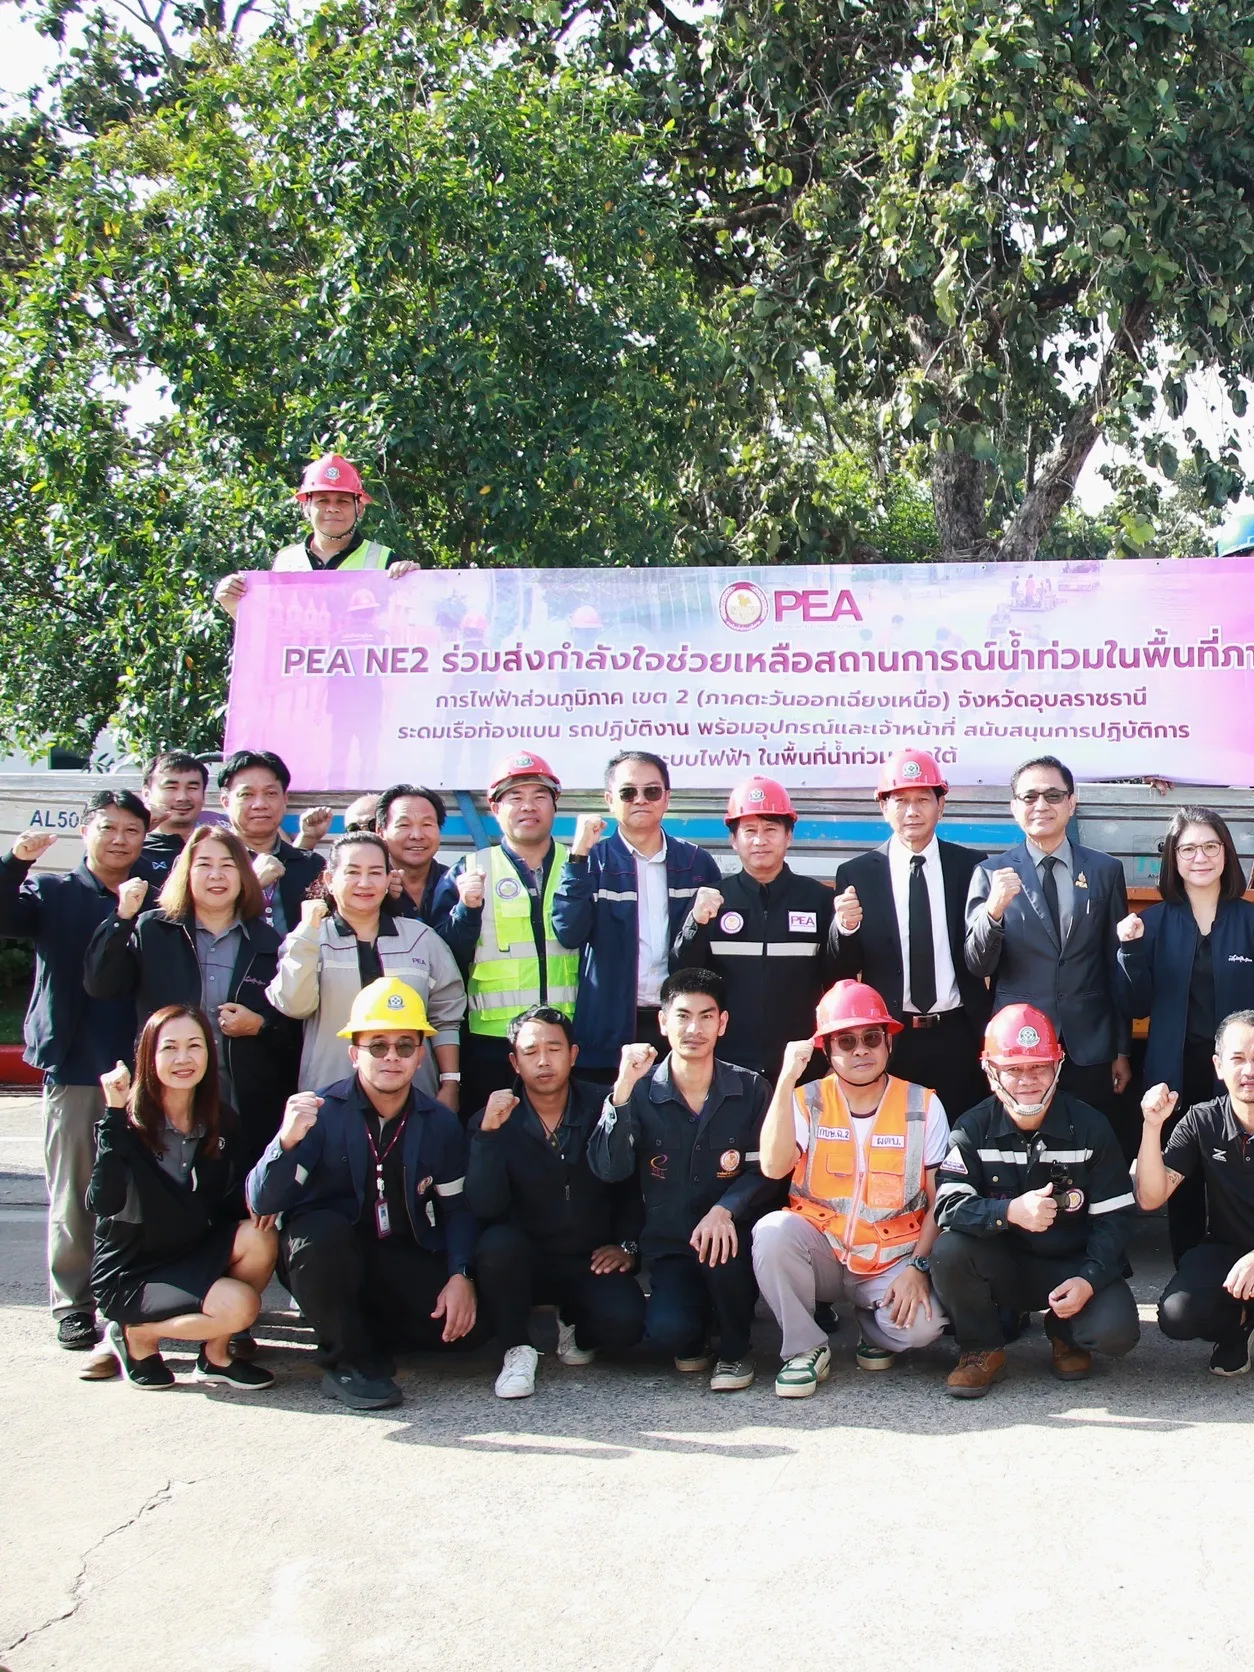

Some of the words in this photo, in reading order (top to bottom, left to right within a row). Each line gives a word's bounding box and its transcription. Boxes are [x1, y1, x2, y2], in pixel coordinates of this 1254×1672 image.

[774, 590, 863, 622] PEA
[284, 648, 353, 674] PEA
[366, 647, 429, 674] NE2
[436, 688, 624, 712] การไฟฟ้าส่วนภูมิภาค
[632, 691, 668, 705] เขต
[676, 689, 689, 704] 2
[697, 688, 949, 712] (ภาคตะวันออกเฉียงเหนือ)
[958, 687, 1147, 713] จังหวัดอุบลราชธานี
[397, 720, 561, 739] ระดมเรือท้องแบน
[569, 719, 690, 741] รถปฏิบัติงาน
[698, 716, 956, 740] พร้อมอุปกรณ์และเจ้าหน้าที่
[963, 720, 1191, 742] สนับสนุนการปฏิบัติการ
[657, 748, 751, 766] ะบบไฟฟ้า
[758, 740, 957, 765] ในพื้นที่น้ำท่วมใต้
[790, 915, 815, 925] PEA
